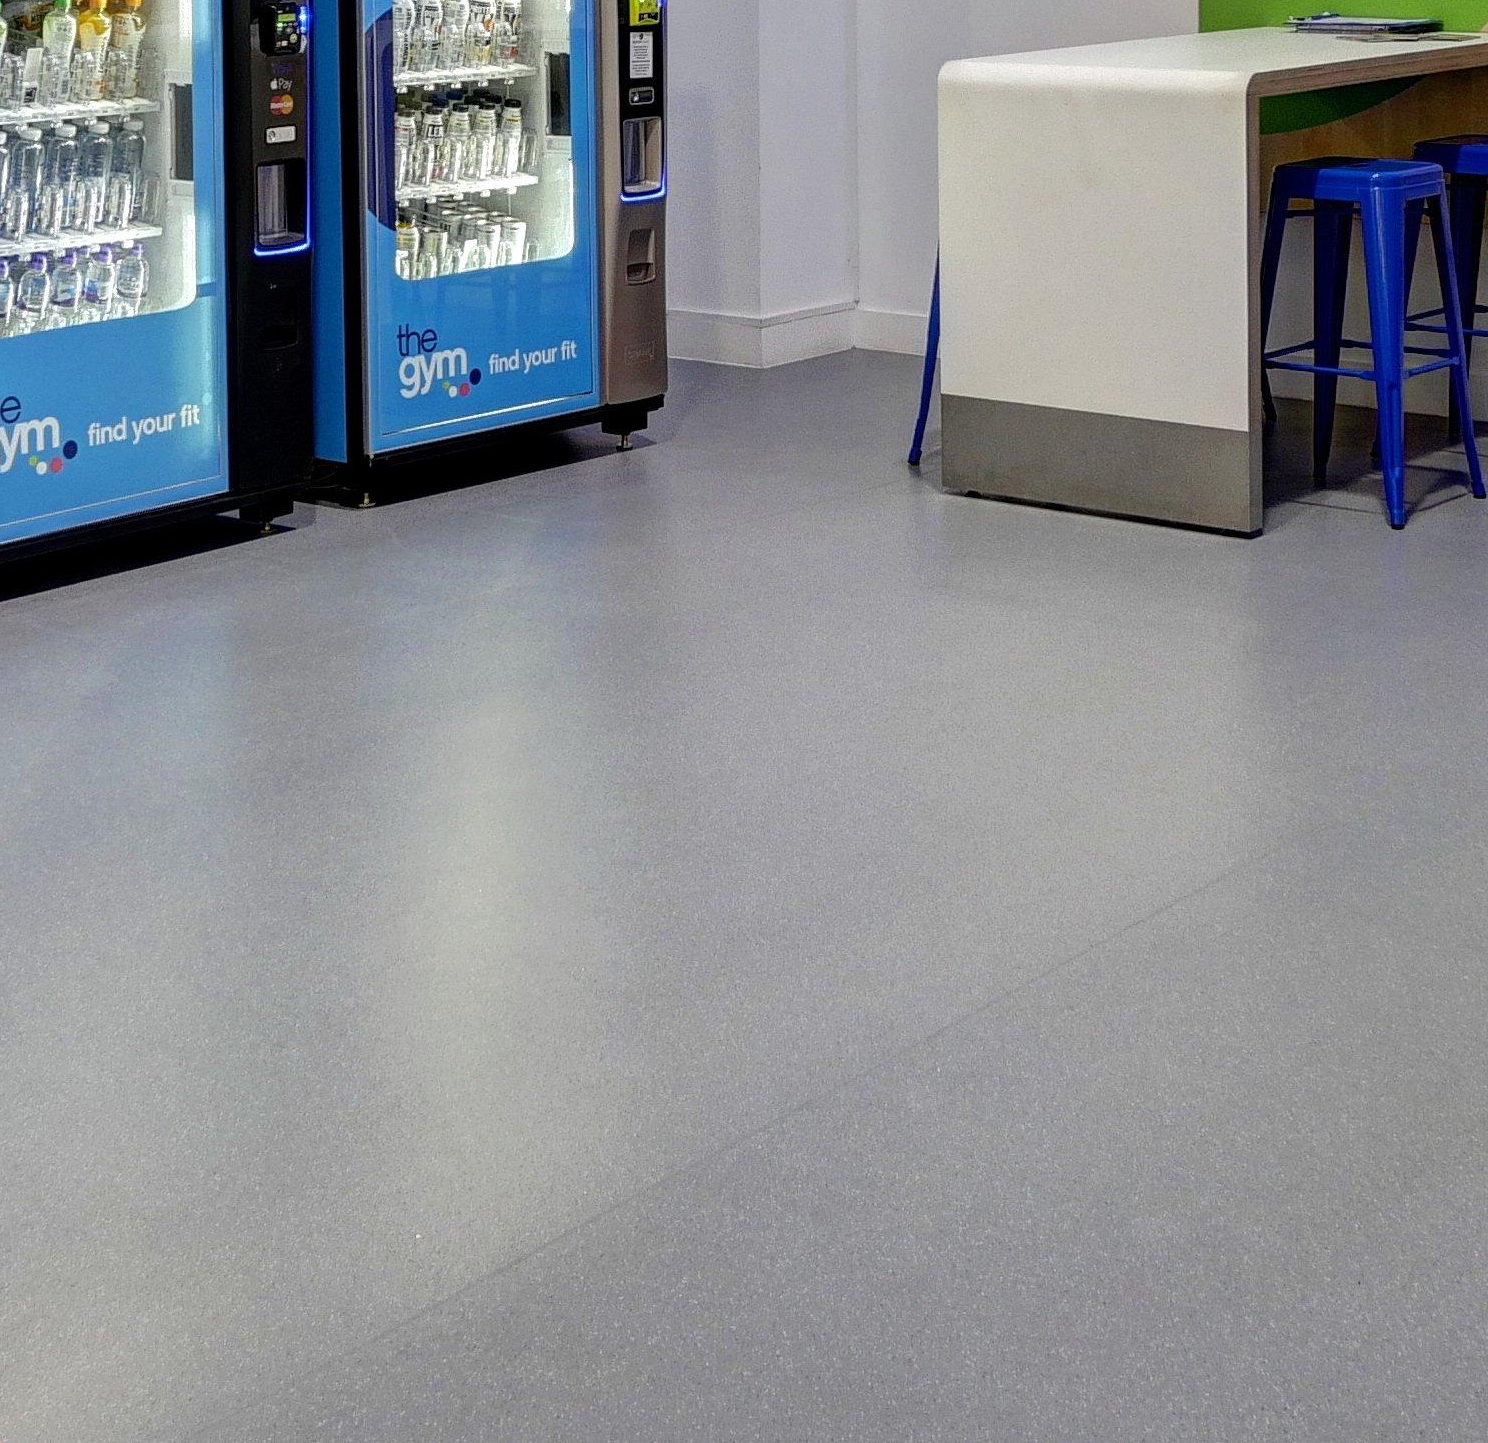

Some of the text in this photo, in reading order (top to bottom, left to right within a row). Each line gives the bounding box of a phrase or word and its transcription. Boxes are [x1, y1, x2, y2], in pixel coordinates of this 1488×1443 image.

[278, 79, 293, 92] Pay
[397, 323, 438, 356] the
[399, 340, 577, 398] gym find your fit
[87, 416, 126, 447] find
[131, 411, 176, 444] your
[180, 404, 201, 428] fit
